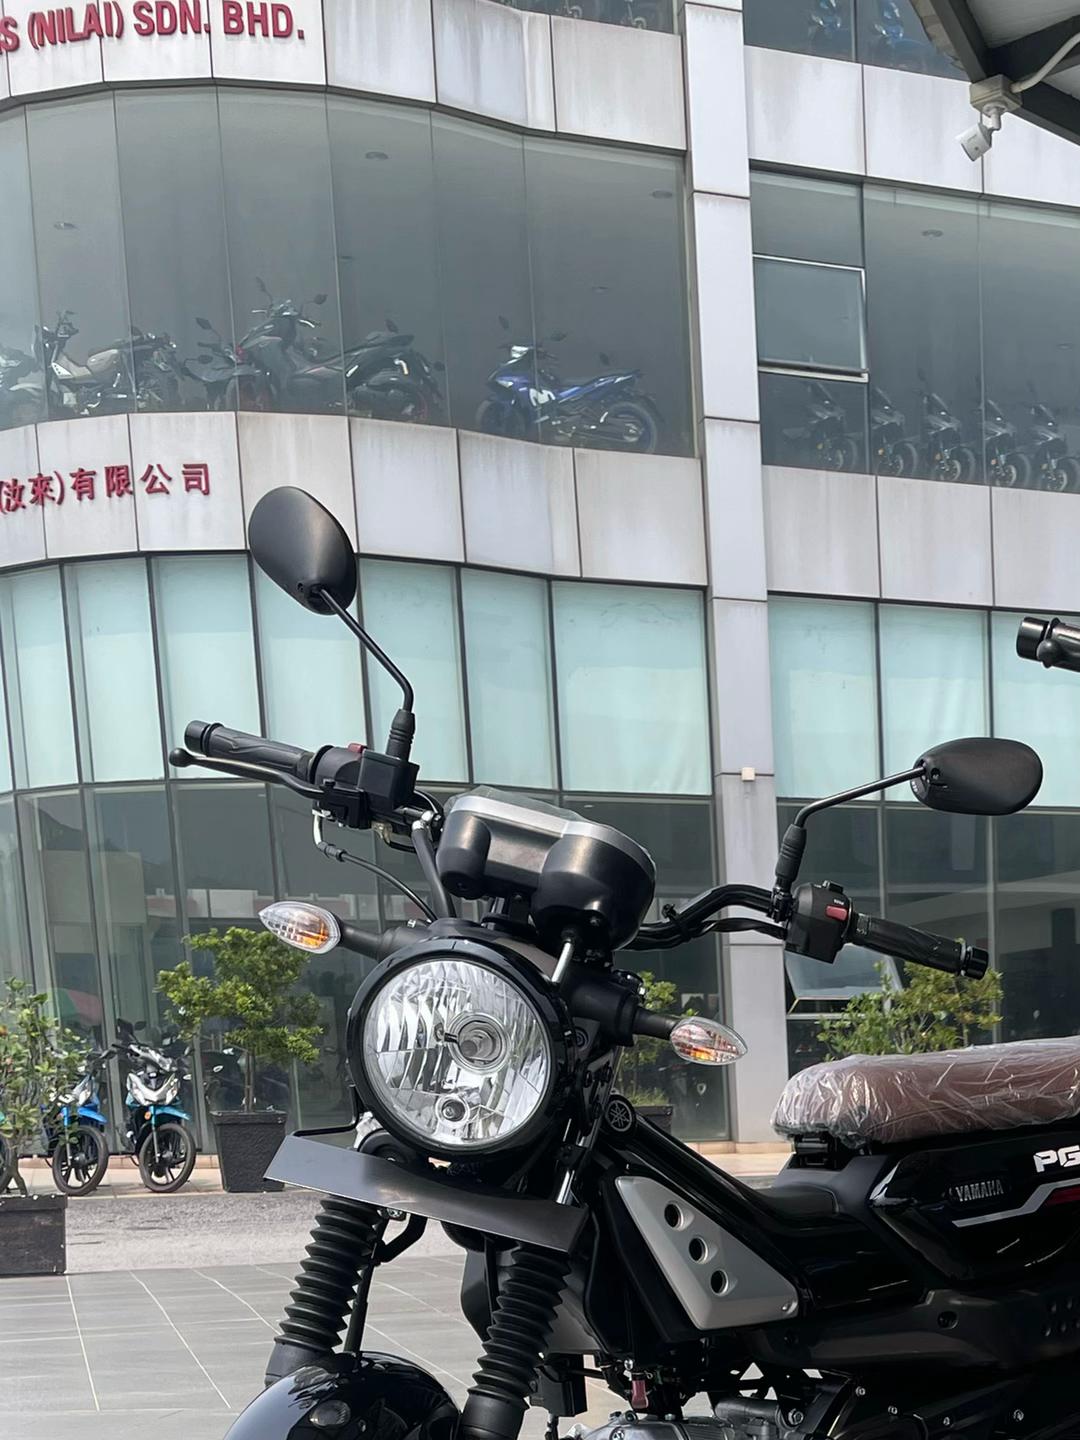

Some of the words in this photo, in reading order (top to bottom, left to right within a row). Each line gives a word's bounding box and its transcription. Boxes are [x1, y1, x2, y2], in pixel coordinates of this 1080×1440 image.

[0, 16, 20, 54] S
[27, 1, 125, 50] (NILAI)
[133, 0, 211, 36] SDN.
[222, 0, 305, 40] BHD.
[955, 1178, 1004, 1202] YAMAHA
